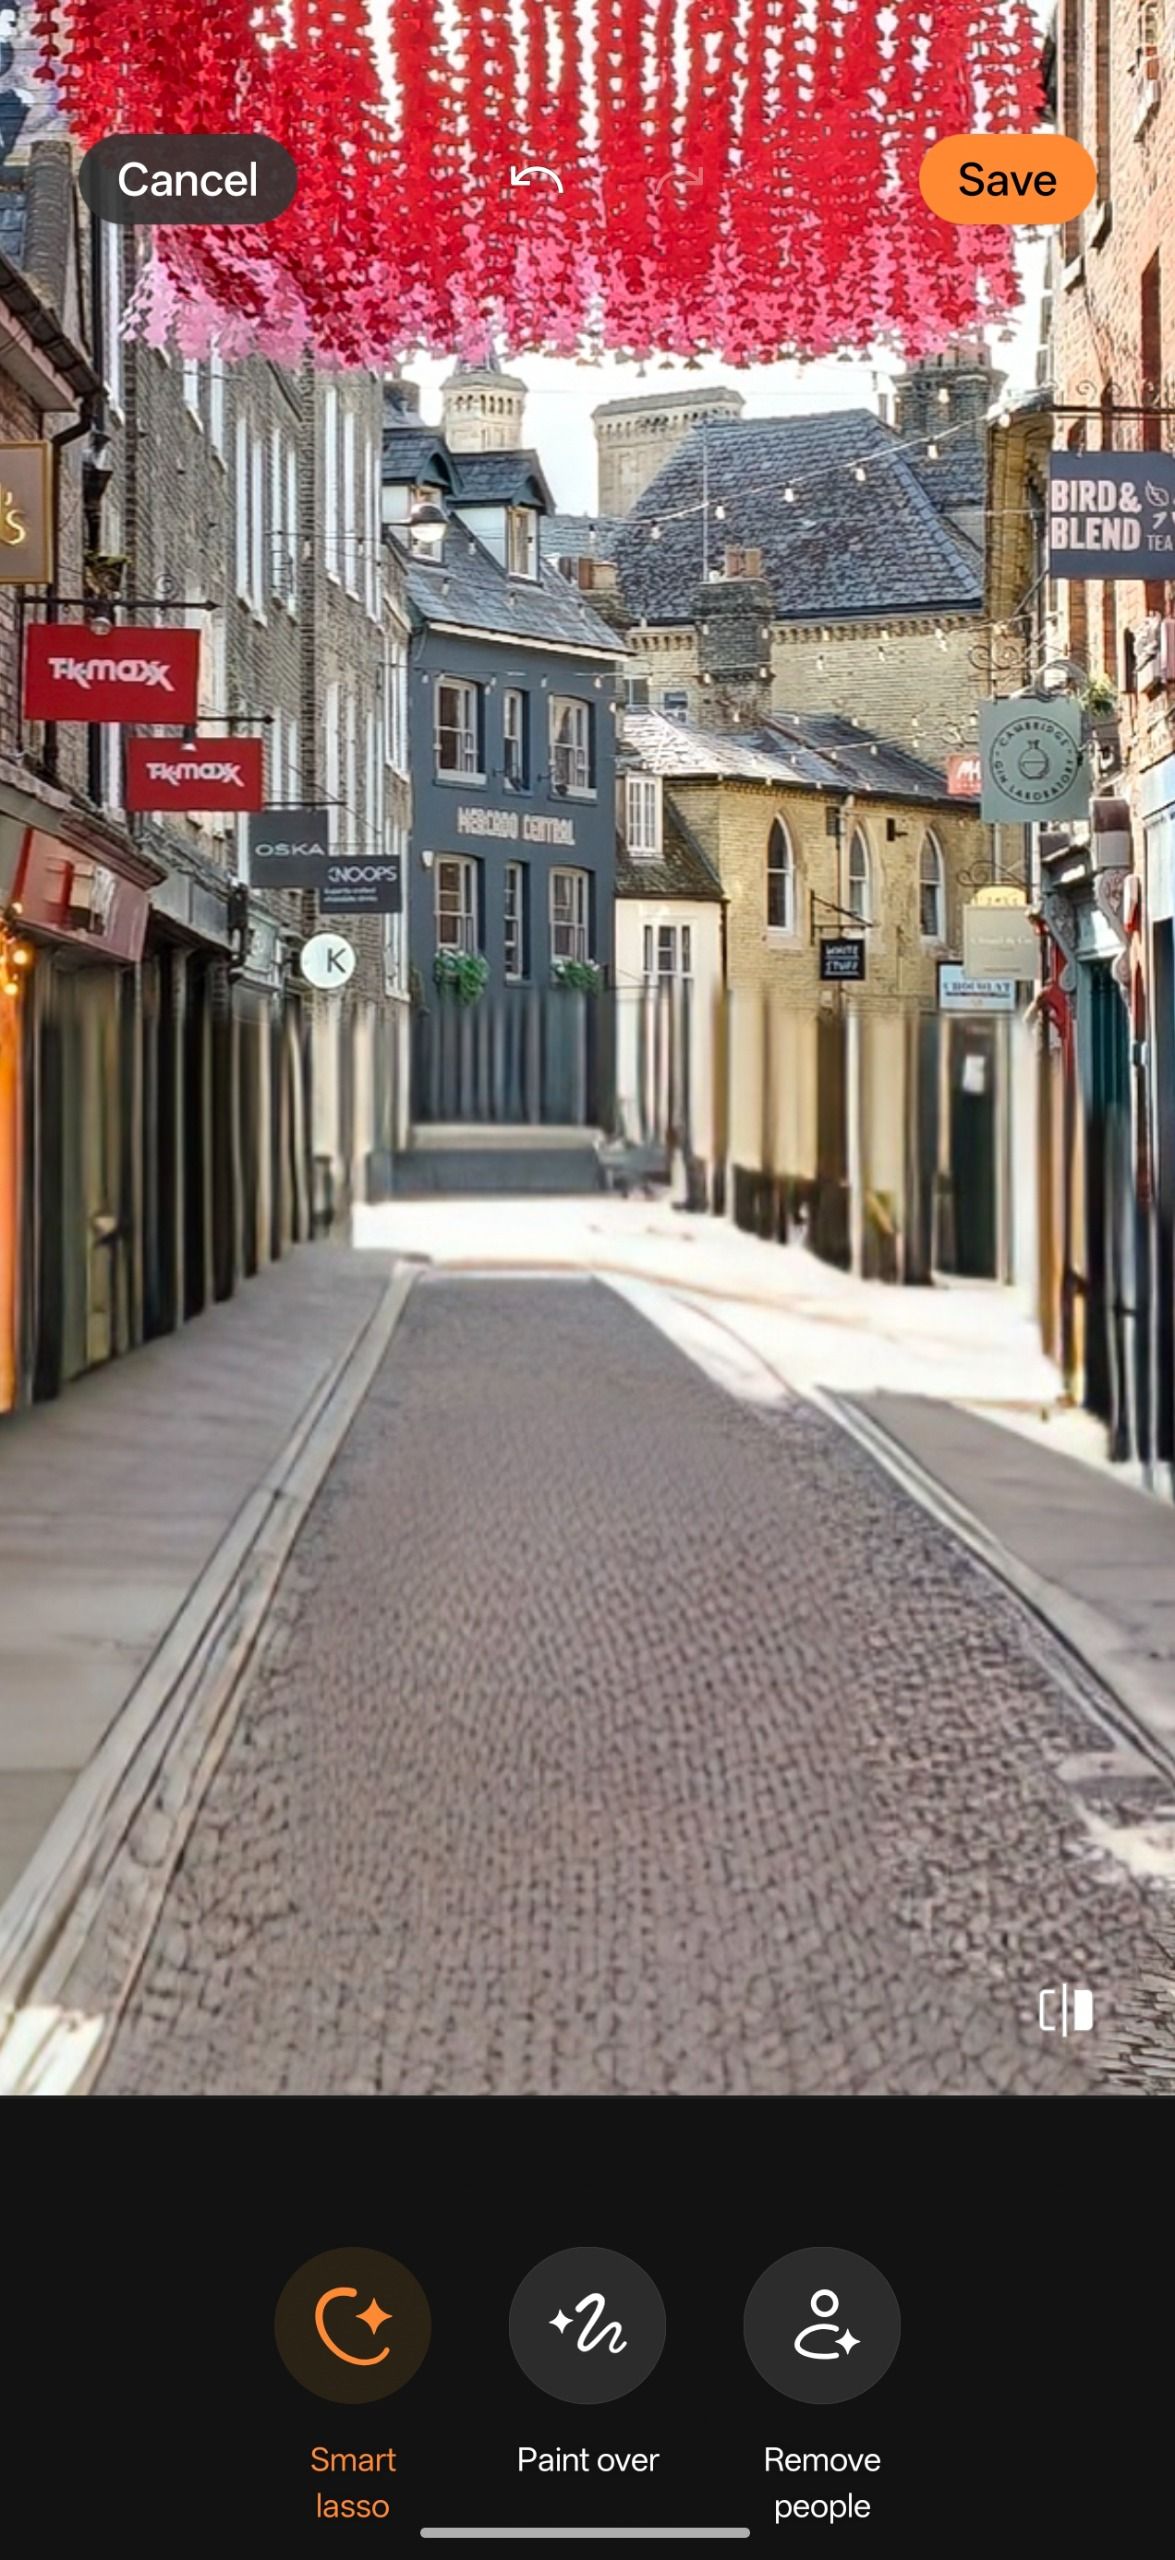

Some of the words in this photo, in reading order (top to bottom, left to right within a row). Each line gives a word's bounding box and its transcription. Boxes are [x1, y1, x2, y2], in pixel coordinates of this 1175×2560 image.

[1051, 517, 1140, 551] BLEND
[1146, 534, 1173, 551] TEA
[999, 721, 1069, 746] CAMBRIDGE
[994, 760, 1008, 784] GIN
[1009, 760, 1074, 800] LABORATORY
[254, 844, 325, 857] OSKA
[327, 948, 346, 973] K
